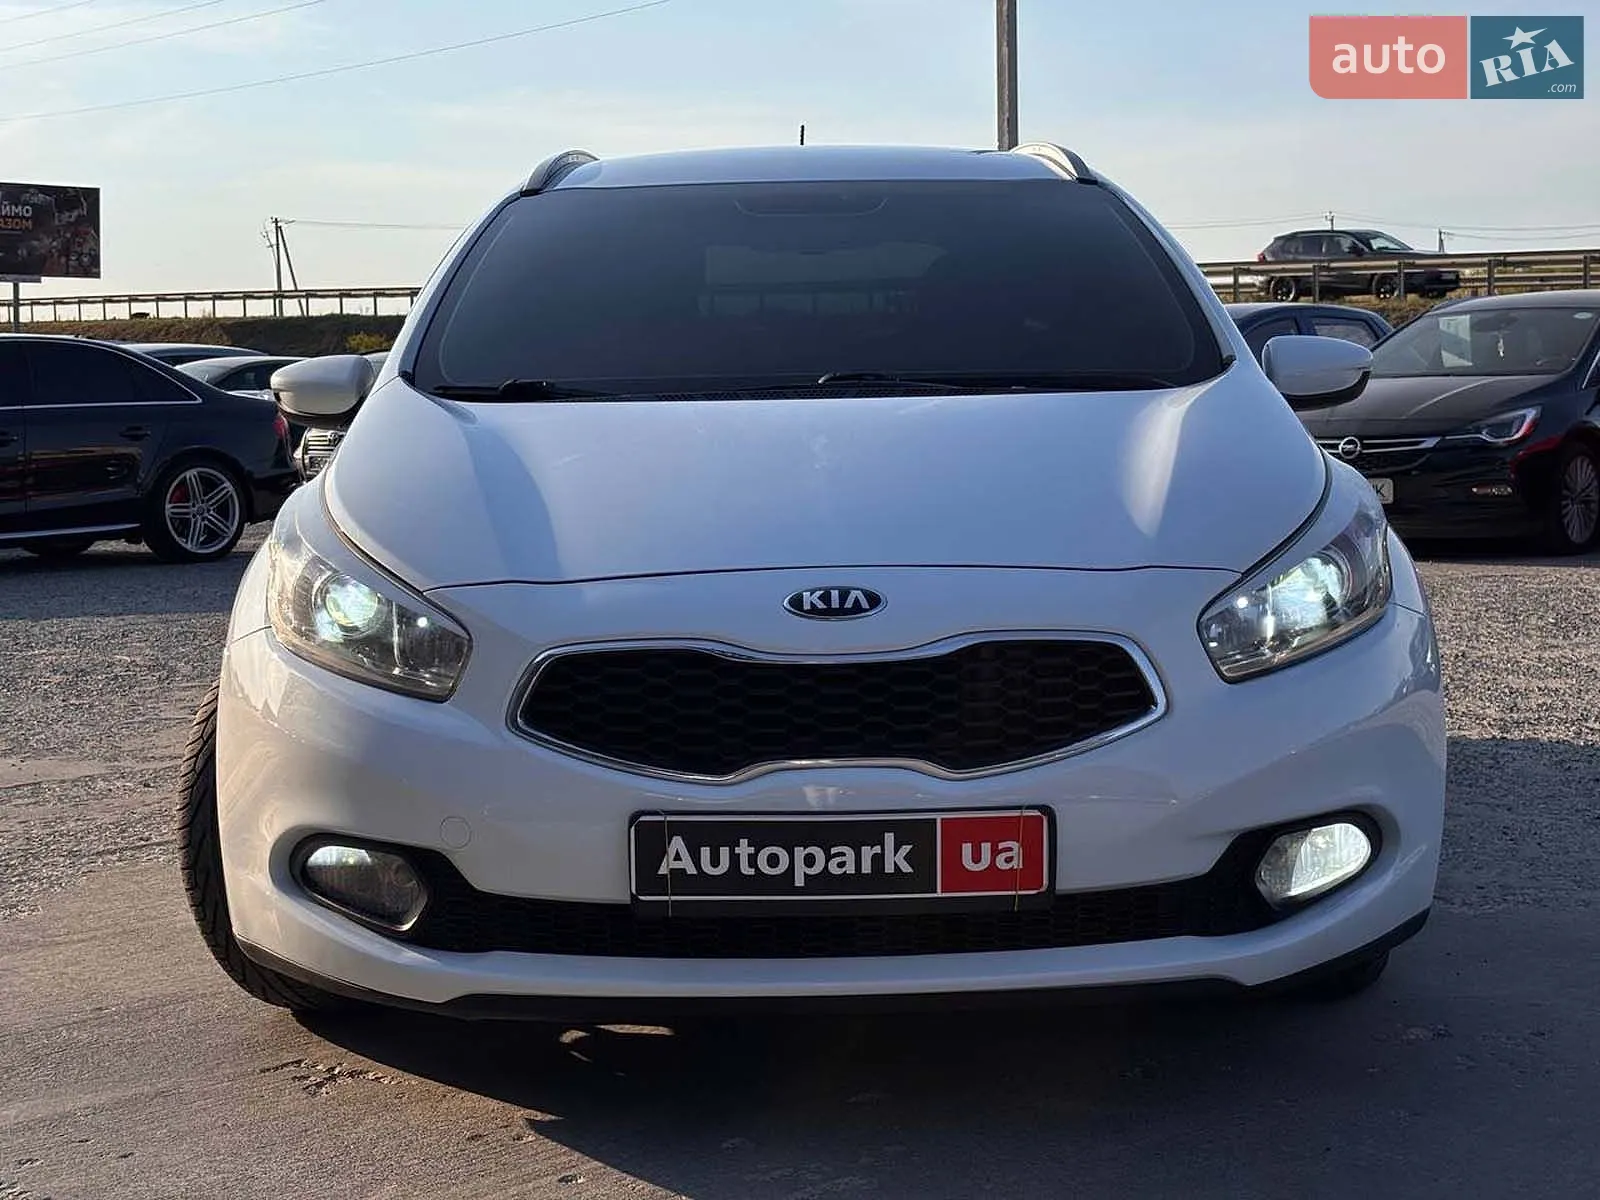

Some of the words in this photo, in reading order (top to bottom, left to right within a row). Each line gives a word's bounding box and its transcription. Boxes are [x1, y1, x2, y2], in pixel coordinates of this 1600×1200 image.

[802, 589, 870, 611] KIA
[657, 832, 914, 887] Autopark
[961, 840, 1023, 872] ua
